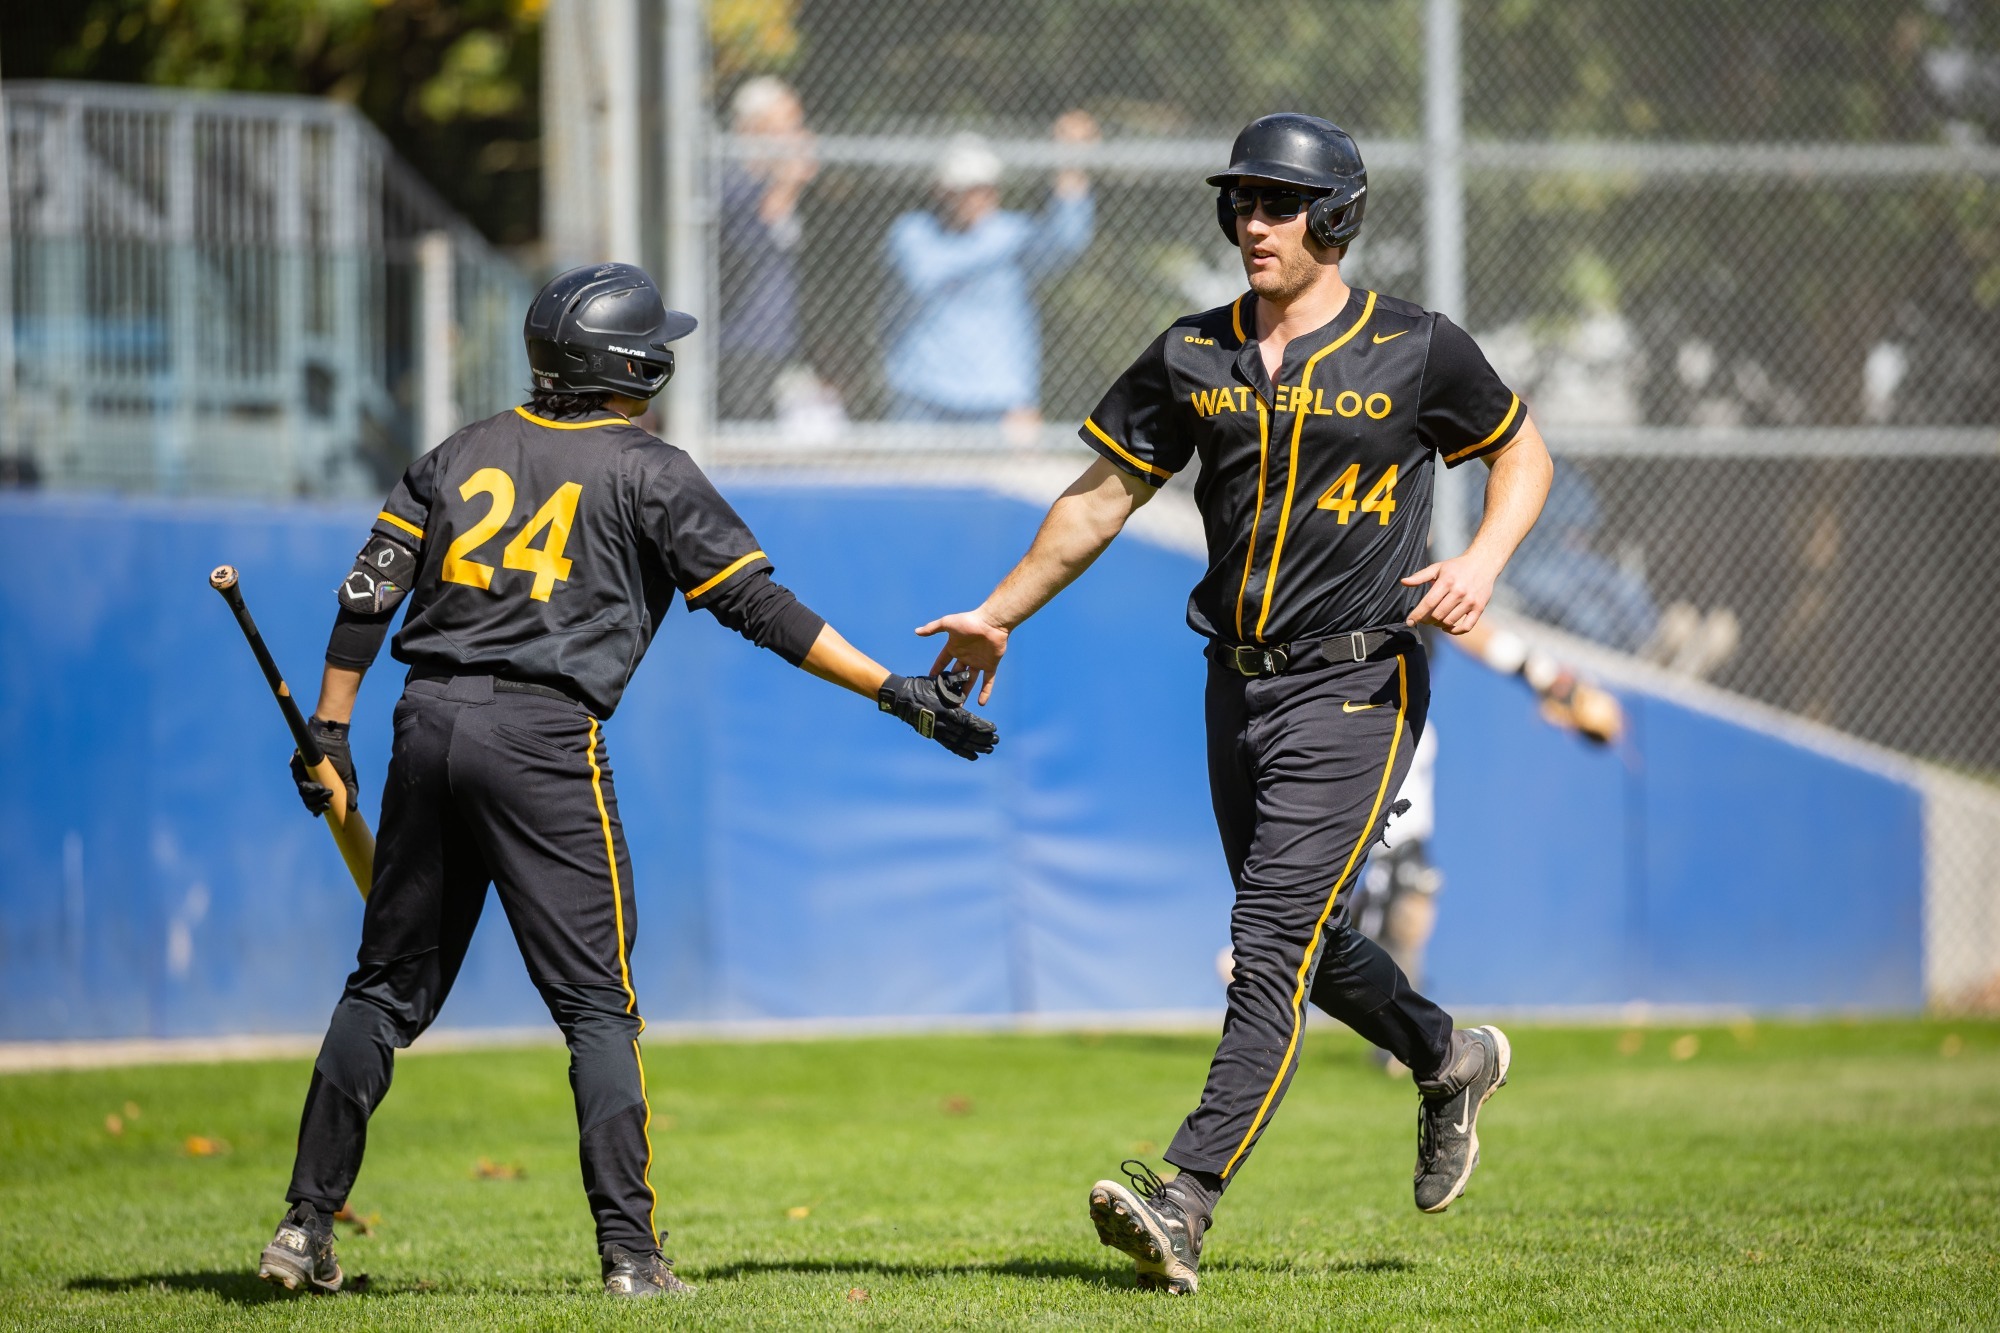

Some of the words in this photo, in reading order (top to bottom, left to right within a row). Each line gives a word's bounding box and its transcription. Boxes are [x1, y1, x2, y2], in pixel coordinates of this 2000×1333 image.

[608, 344, 646, 357] RAWLINGS
[1184, 335, 1214, 346] OUA
[1190, 384, 1392, 420] WATERLOO
[1317, 463, 1399, 526] 44
[441, 467, 583, 602] 24
